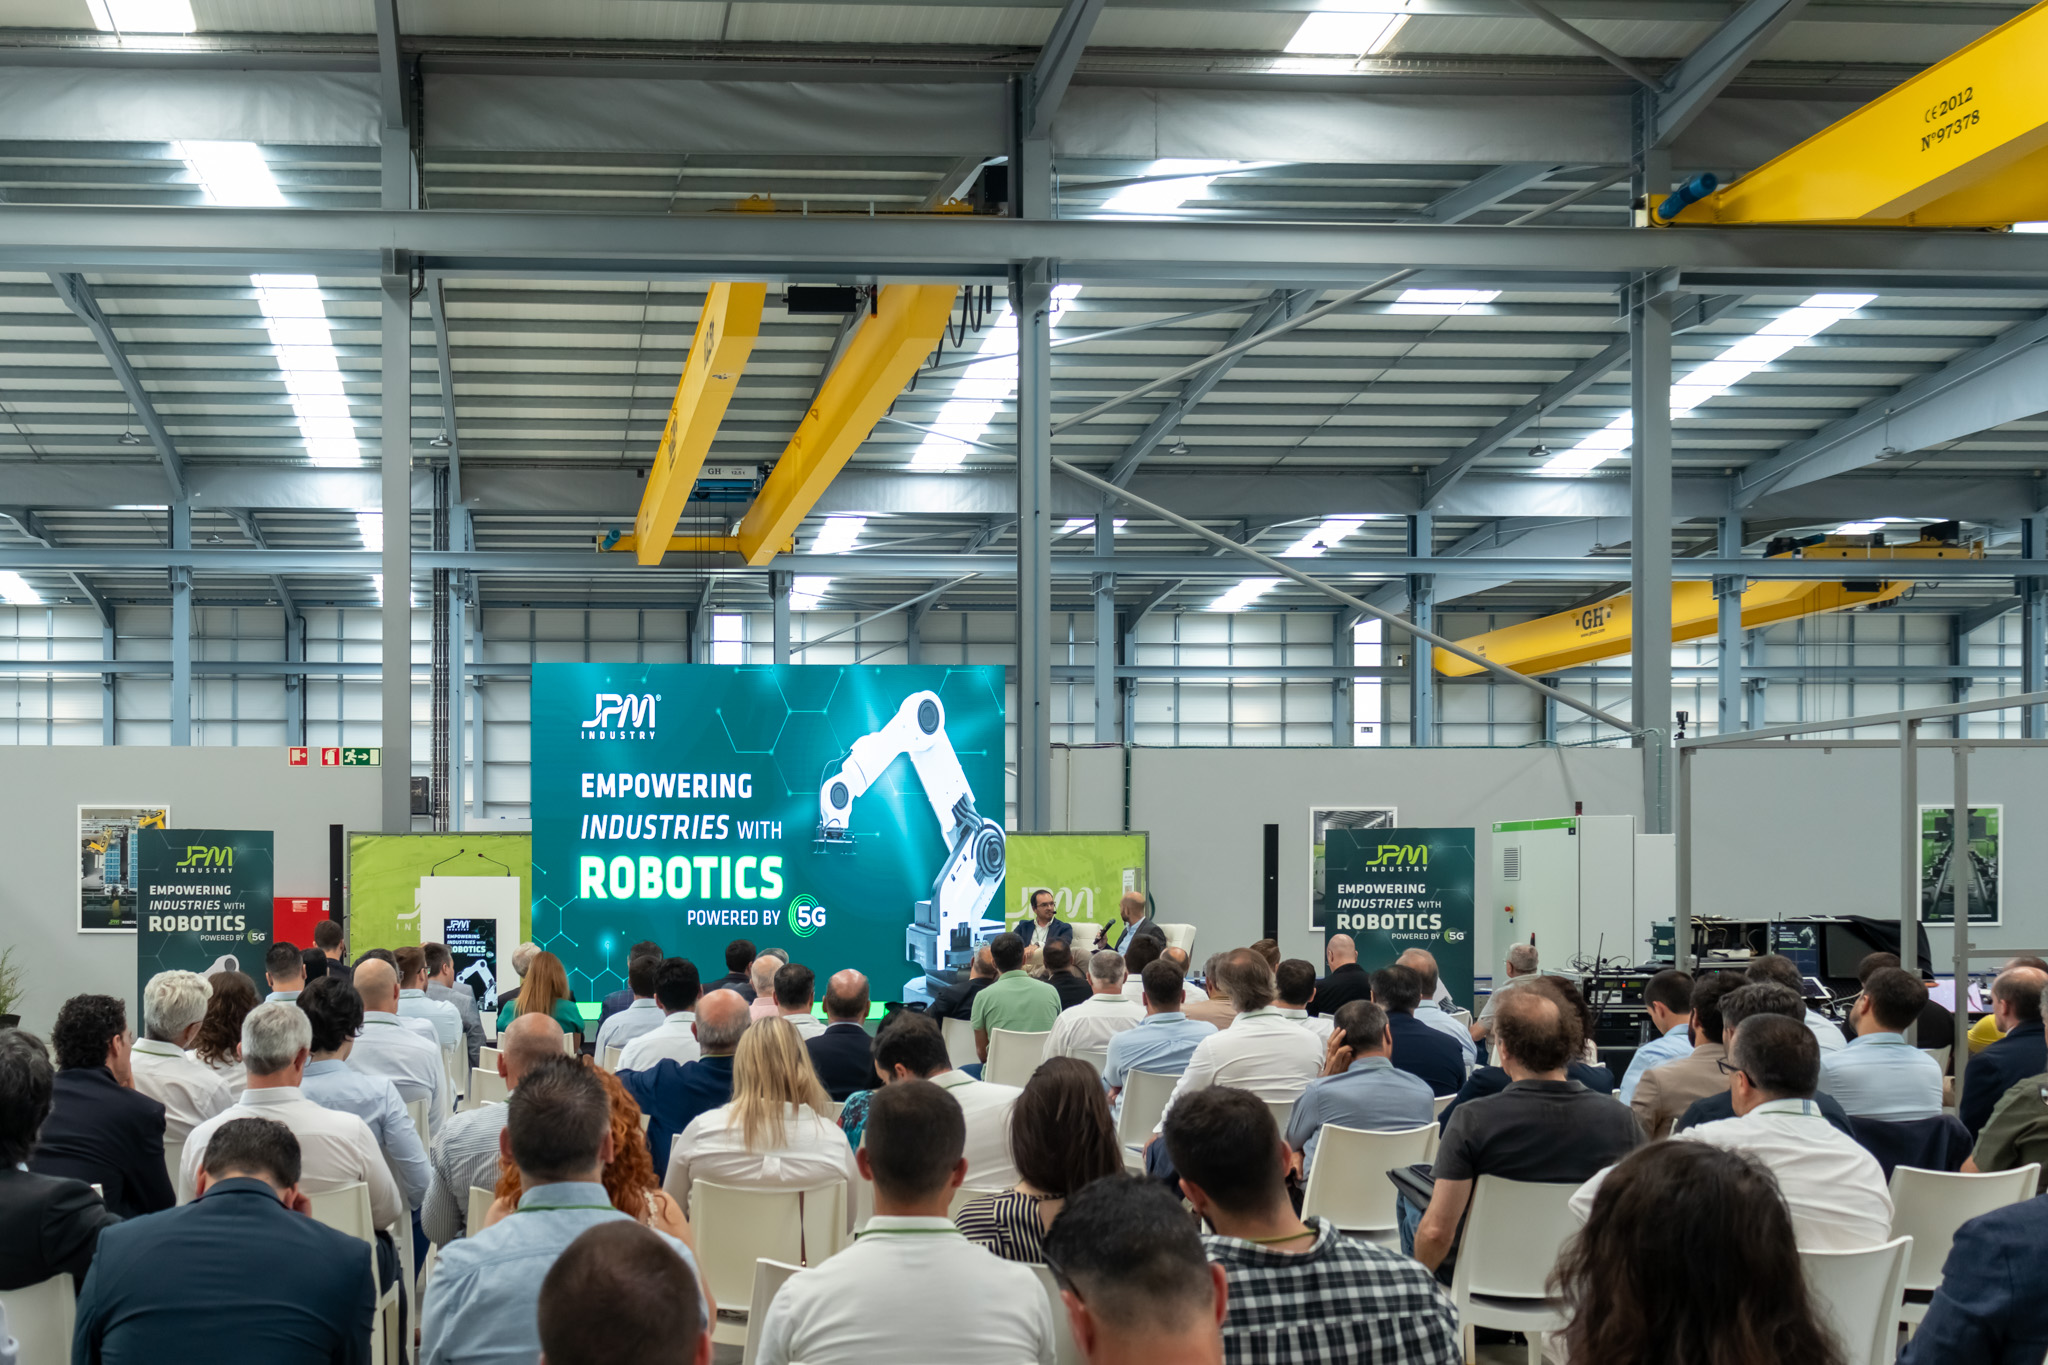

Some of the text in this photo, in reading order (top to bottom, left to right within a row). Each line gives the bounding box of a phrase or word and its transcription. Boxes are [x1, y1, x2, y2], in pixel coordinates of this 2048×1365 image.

[1582, 607, 1604, 630] GH
[581, 731, 656, 739] INDUSTRY
[581, 773, 752, 798] EMPOWERING
[581, 814, 782, 839] INDUSTRIES WITH
[579, 855, 783, 900] ROBOTICS
[149, 885, 231, 895] EMPOWERING
[1337, 884, 1426, 894] EMPOWERING
[149, 900, 245, 910] INDUSTRIES WITH
[1337, 899, 1414, 909] INDUSTRIES
[687, 906, 826, 927] POWERED BY 5G
[1337, 914, 1442, 930] ROBOTICS
[149, 915, 246, 932] ROBOTICS
[252, 932, 266, 941] 5G
[1449, 932, 1464, 940] 5G
